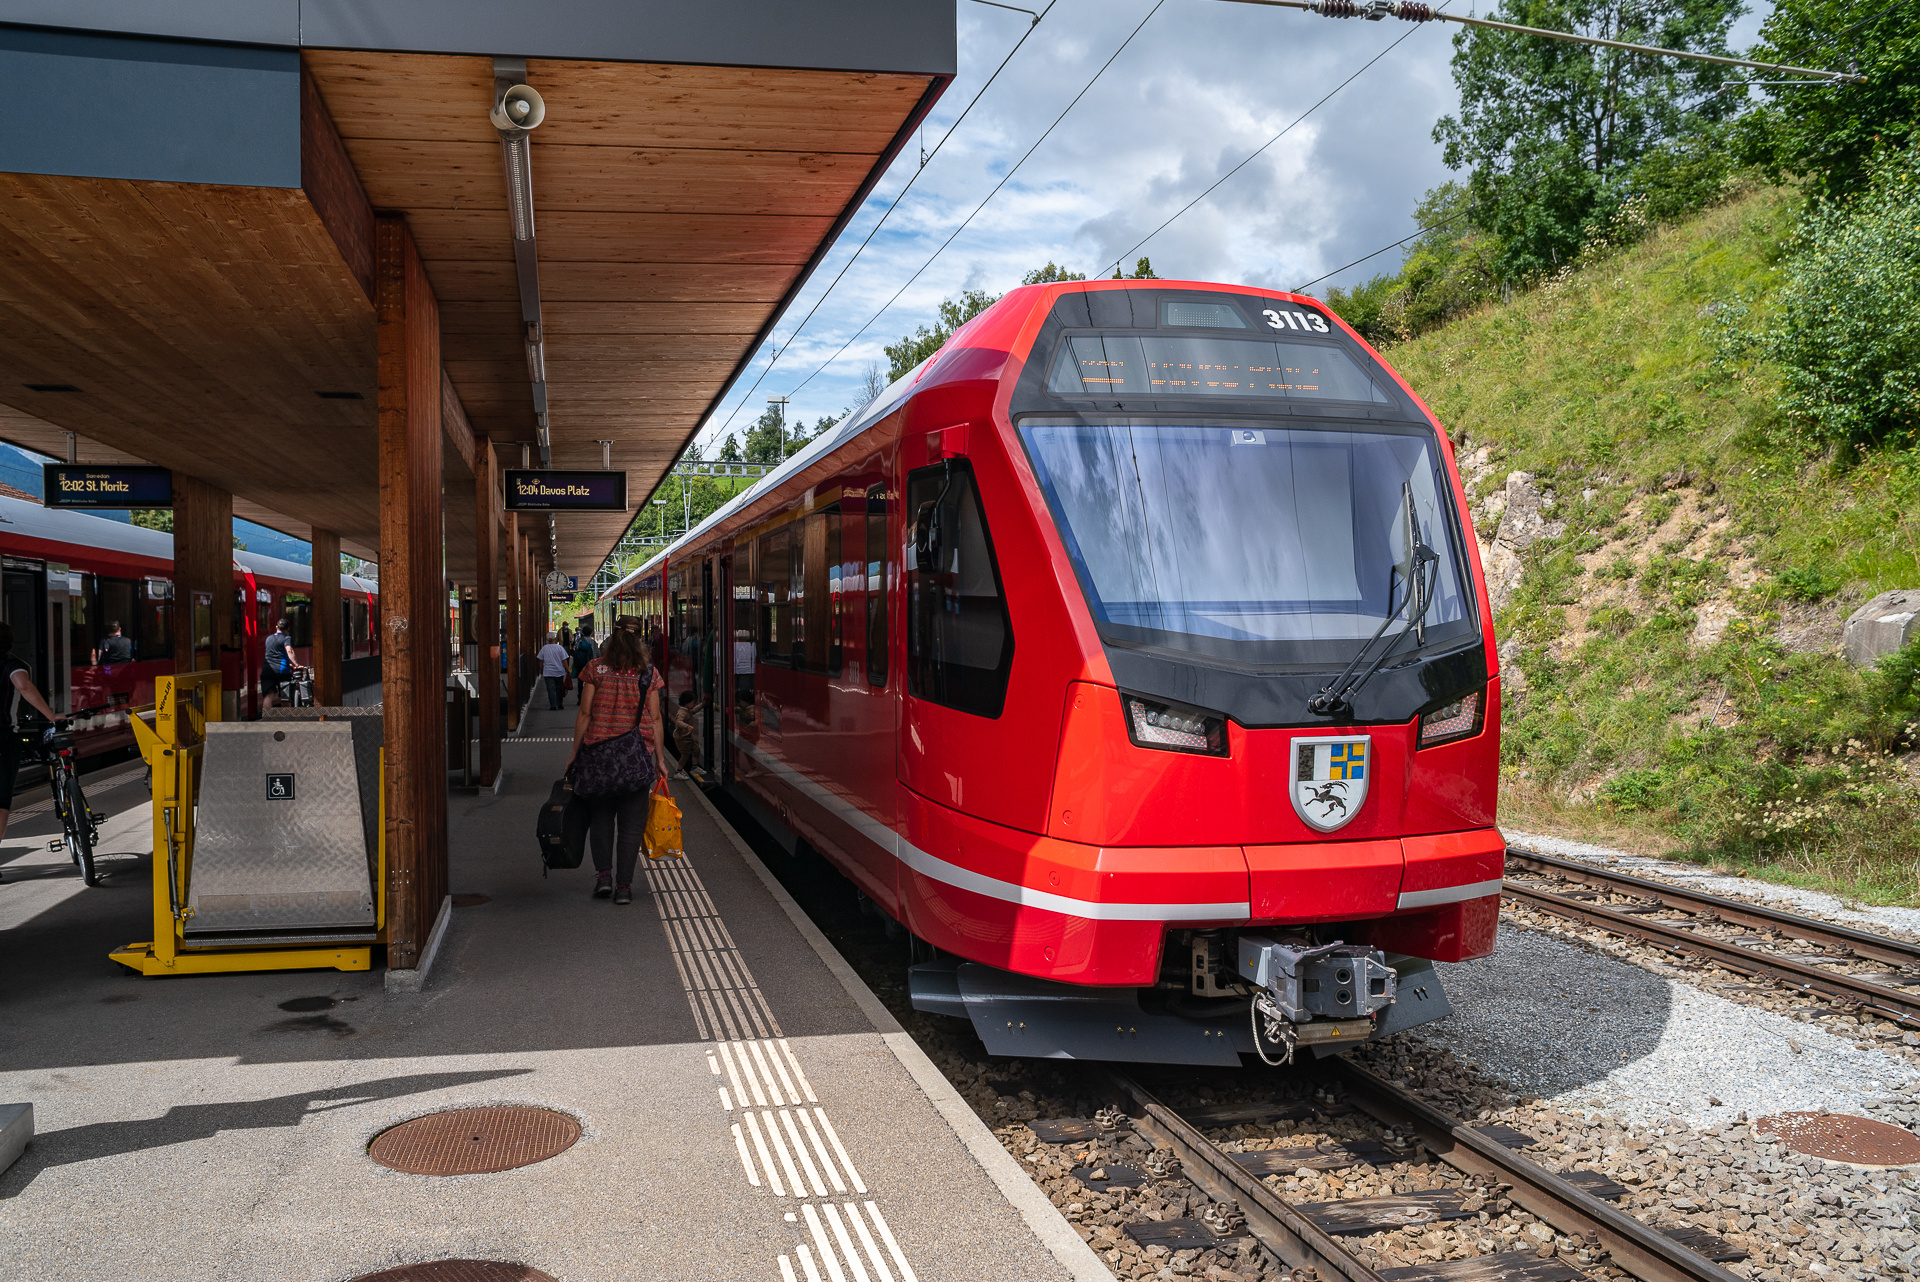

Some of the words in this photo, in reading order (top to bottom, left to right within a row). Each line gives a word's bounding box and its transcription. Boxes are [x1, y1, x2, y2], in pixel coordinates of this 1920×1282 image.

[1262, 309, 1330, 334] 3113
[59, 480, 84, 491] 12:02
[86, 480, 99, 491] St.
[100, 480, 129, 491] Moritz
[517, 484, 538, 495] 12:04
[540, 484, 566, 495] Davos
[567, 484, 590, 495] Platz
[567, 580, 574, 588] 3
